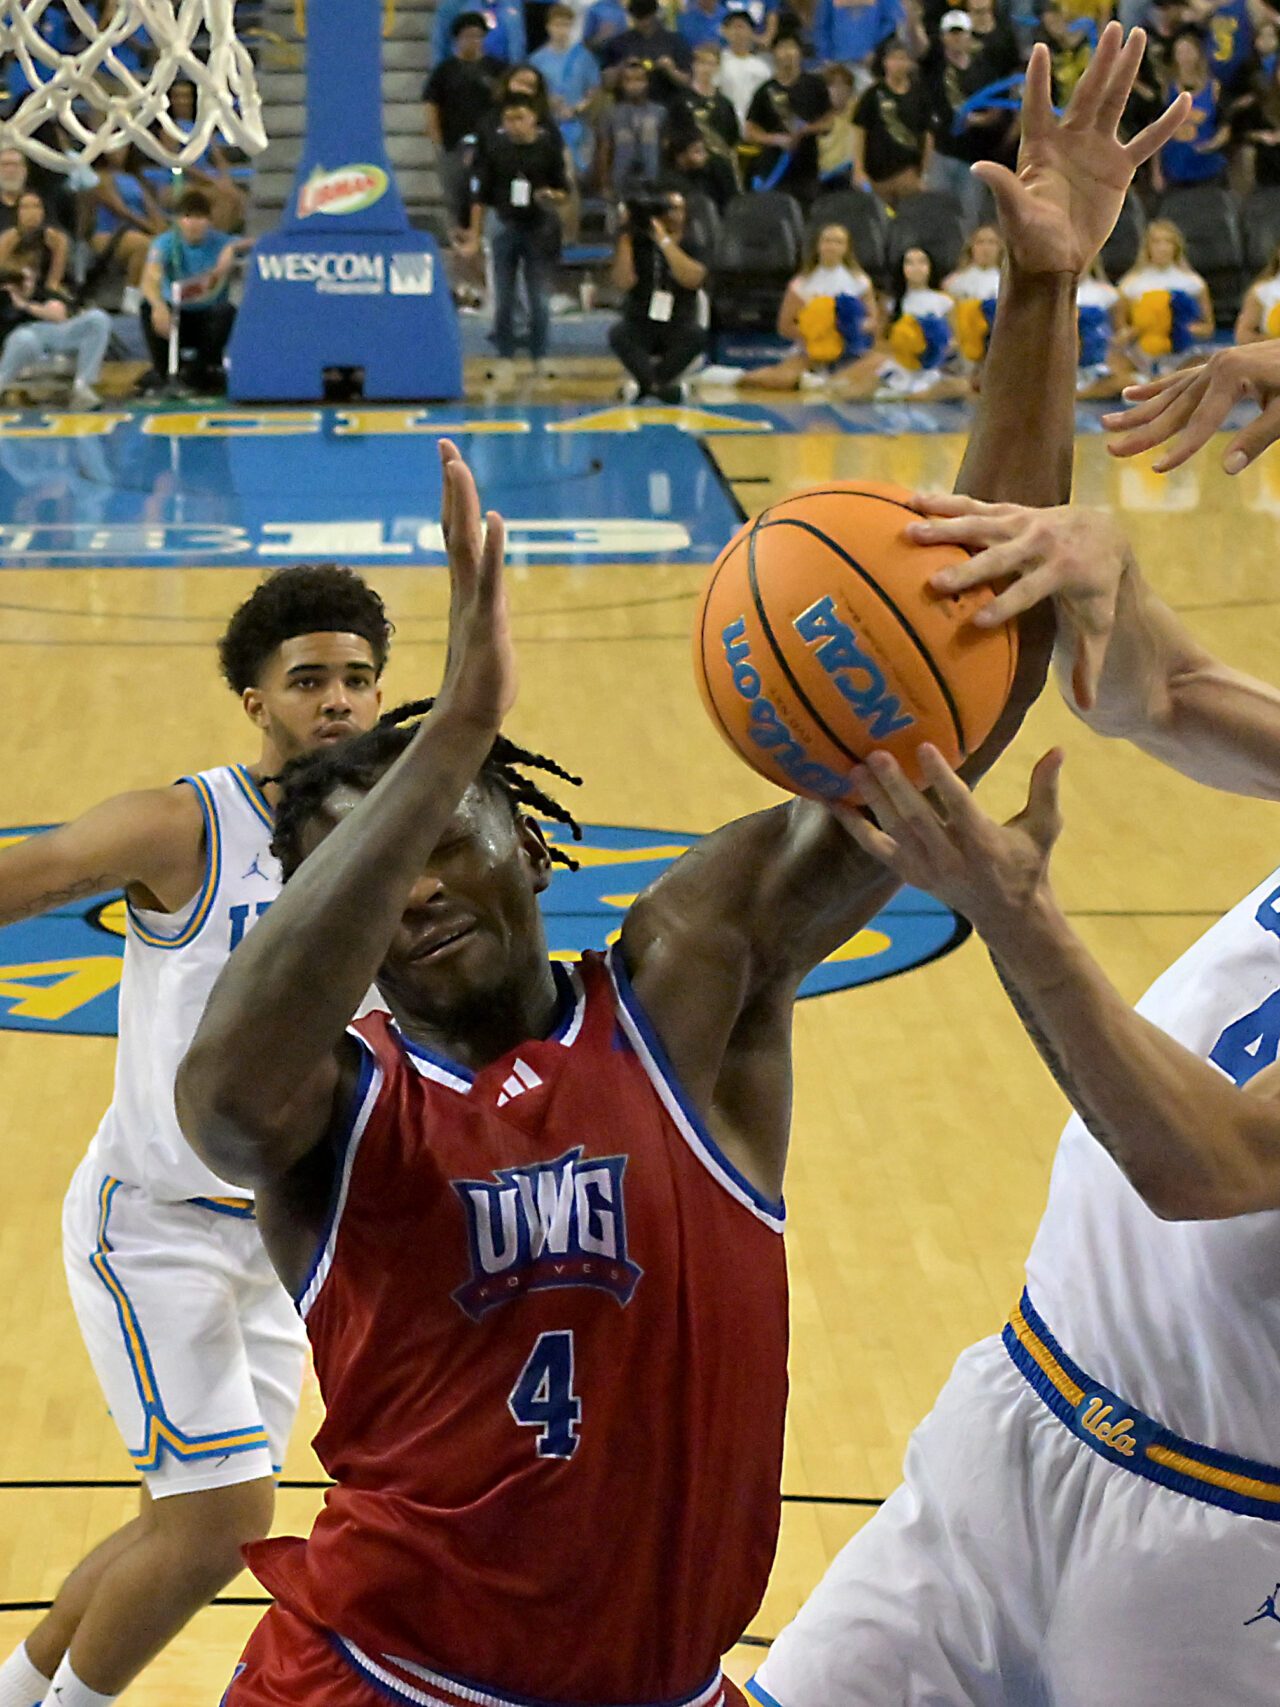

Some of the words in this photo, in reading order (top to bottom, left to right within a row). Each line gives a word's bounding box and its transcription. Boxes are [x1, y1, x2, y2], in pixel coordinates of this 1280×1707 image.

[257, 253, 383, 281] WESCOM
[792, 595, 915, 740] NCAA
[468, 1161, 616, 1274] UWG
[507, 1329, 582, 1460] 4
